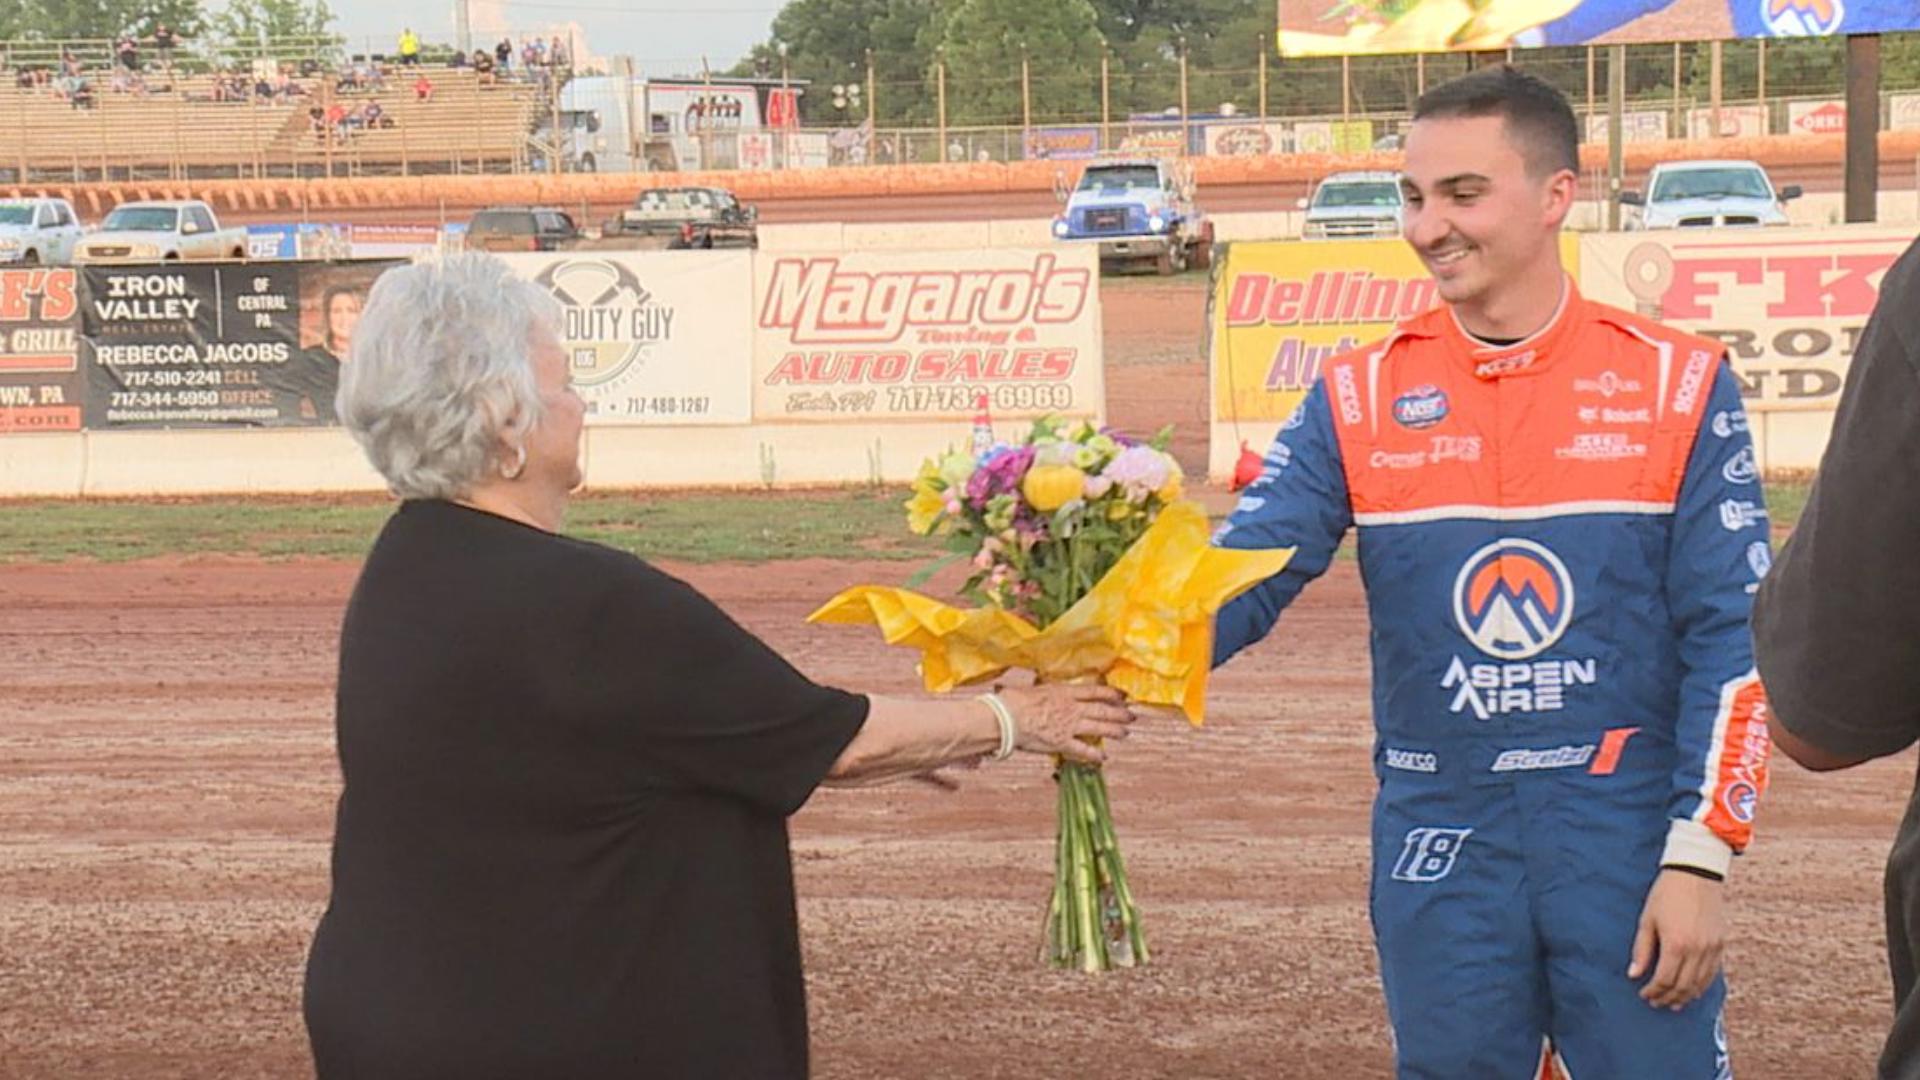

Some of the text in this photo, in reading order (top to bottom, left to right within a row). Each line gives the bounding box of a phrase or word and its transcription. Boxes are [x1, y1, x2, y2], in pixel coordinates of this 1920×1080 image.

[107, 275, 185, 297] IRON
[253, 277, 270, 293] OF
[1660, 254, 1898, 320] FK
[237, 295, 288, 311] CENTRAL
[759, 253, 1091, 344] Magaro's
[95, 299, 200, 321] VALLEY
[255, 313, 272, 329] PA
[102, 321, 194, 334] REAL ESTATE
[566, 308, 674, 341] DUTY GUY
[917, 326, 1010, 344] Towing
[12, 328, 78, 353] GRILL
[1696, 327, 1866, 359] RO
[96, 342, 290, 365] REBECCA JACOBS
[764, 347, 1077, 385] AUTO SALES
[124, 369, 260, 386] 717-510-2241 CELL
[40, 385, 64, 404] PA
[111, 390, 273, 407] 717-344-5950 OFFICE
[626, 397, 710, 413] 717-480-1267
[1440, 656, 1598, 688] ASPEN
[1392, 827, 1475, 882] 18
